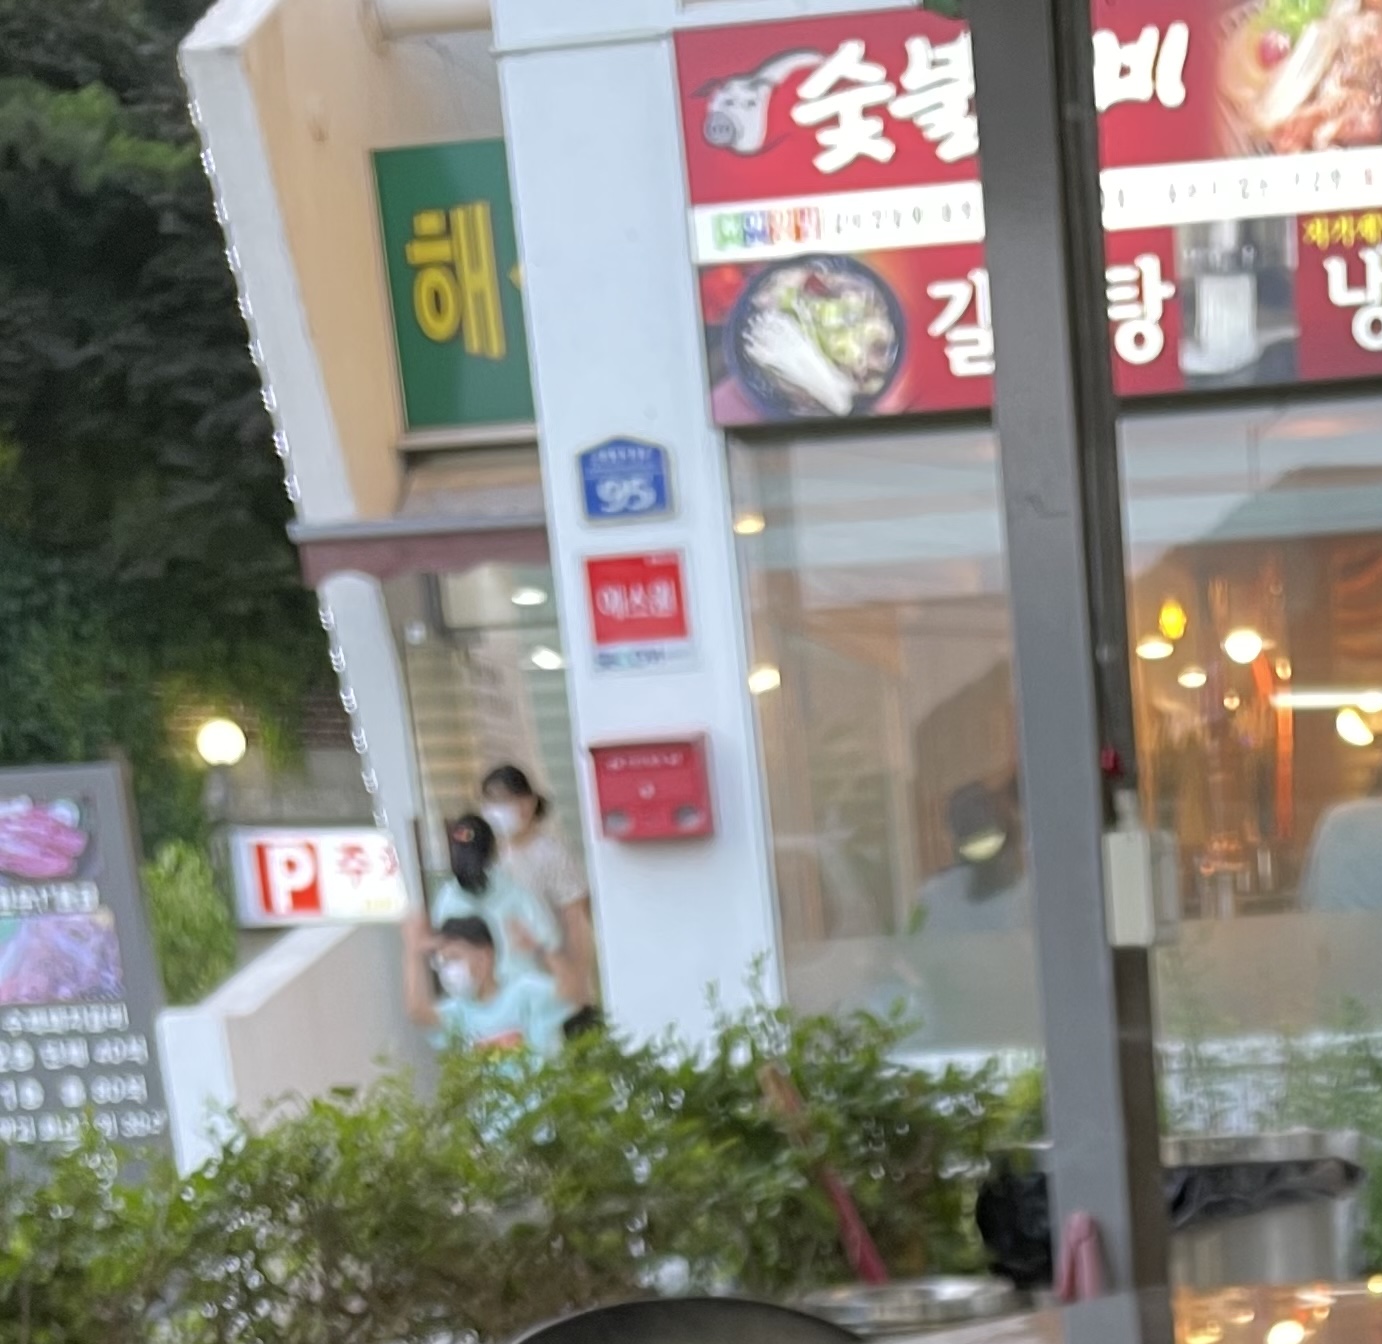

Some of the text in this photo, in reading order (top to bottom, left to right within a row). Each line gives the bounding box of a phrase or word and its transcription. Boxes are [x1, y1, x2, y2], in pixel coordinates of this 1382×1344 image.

[790, 20, 1190, 174] 숯불비
[596, 477, 657, 514] 95
[269, 843, 317, 914] P
